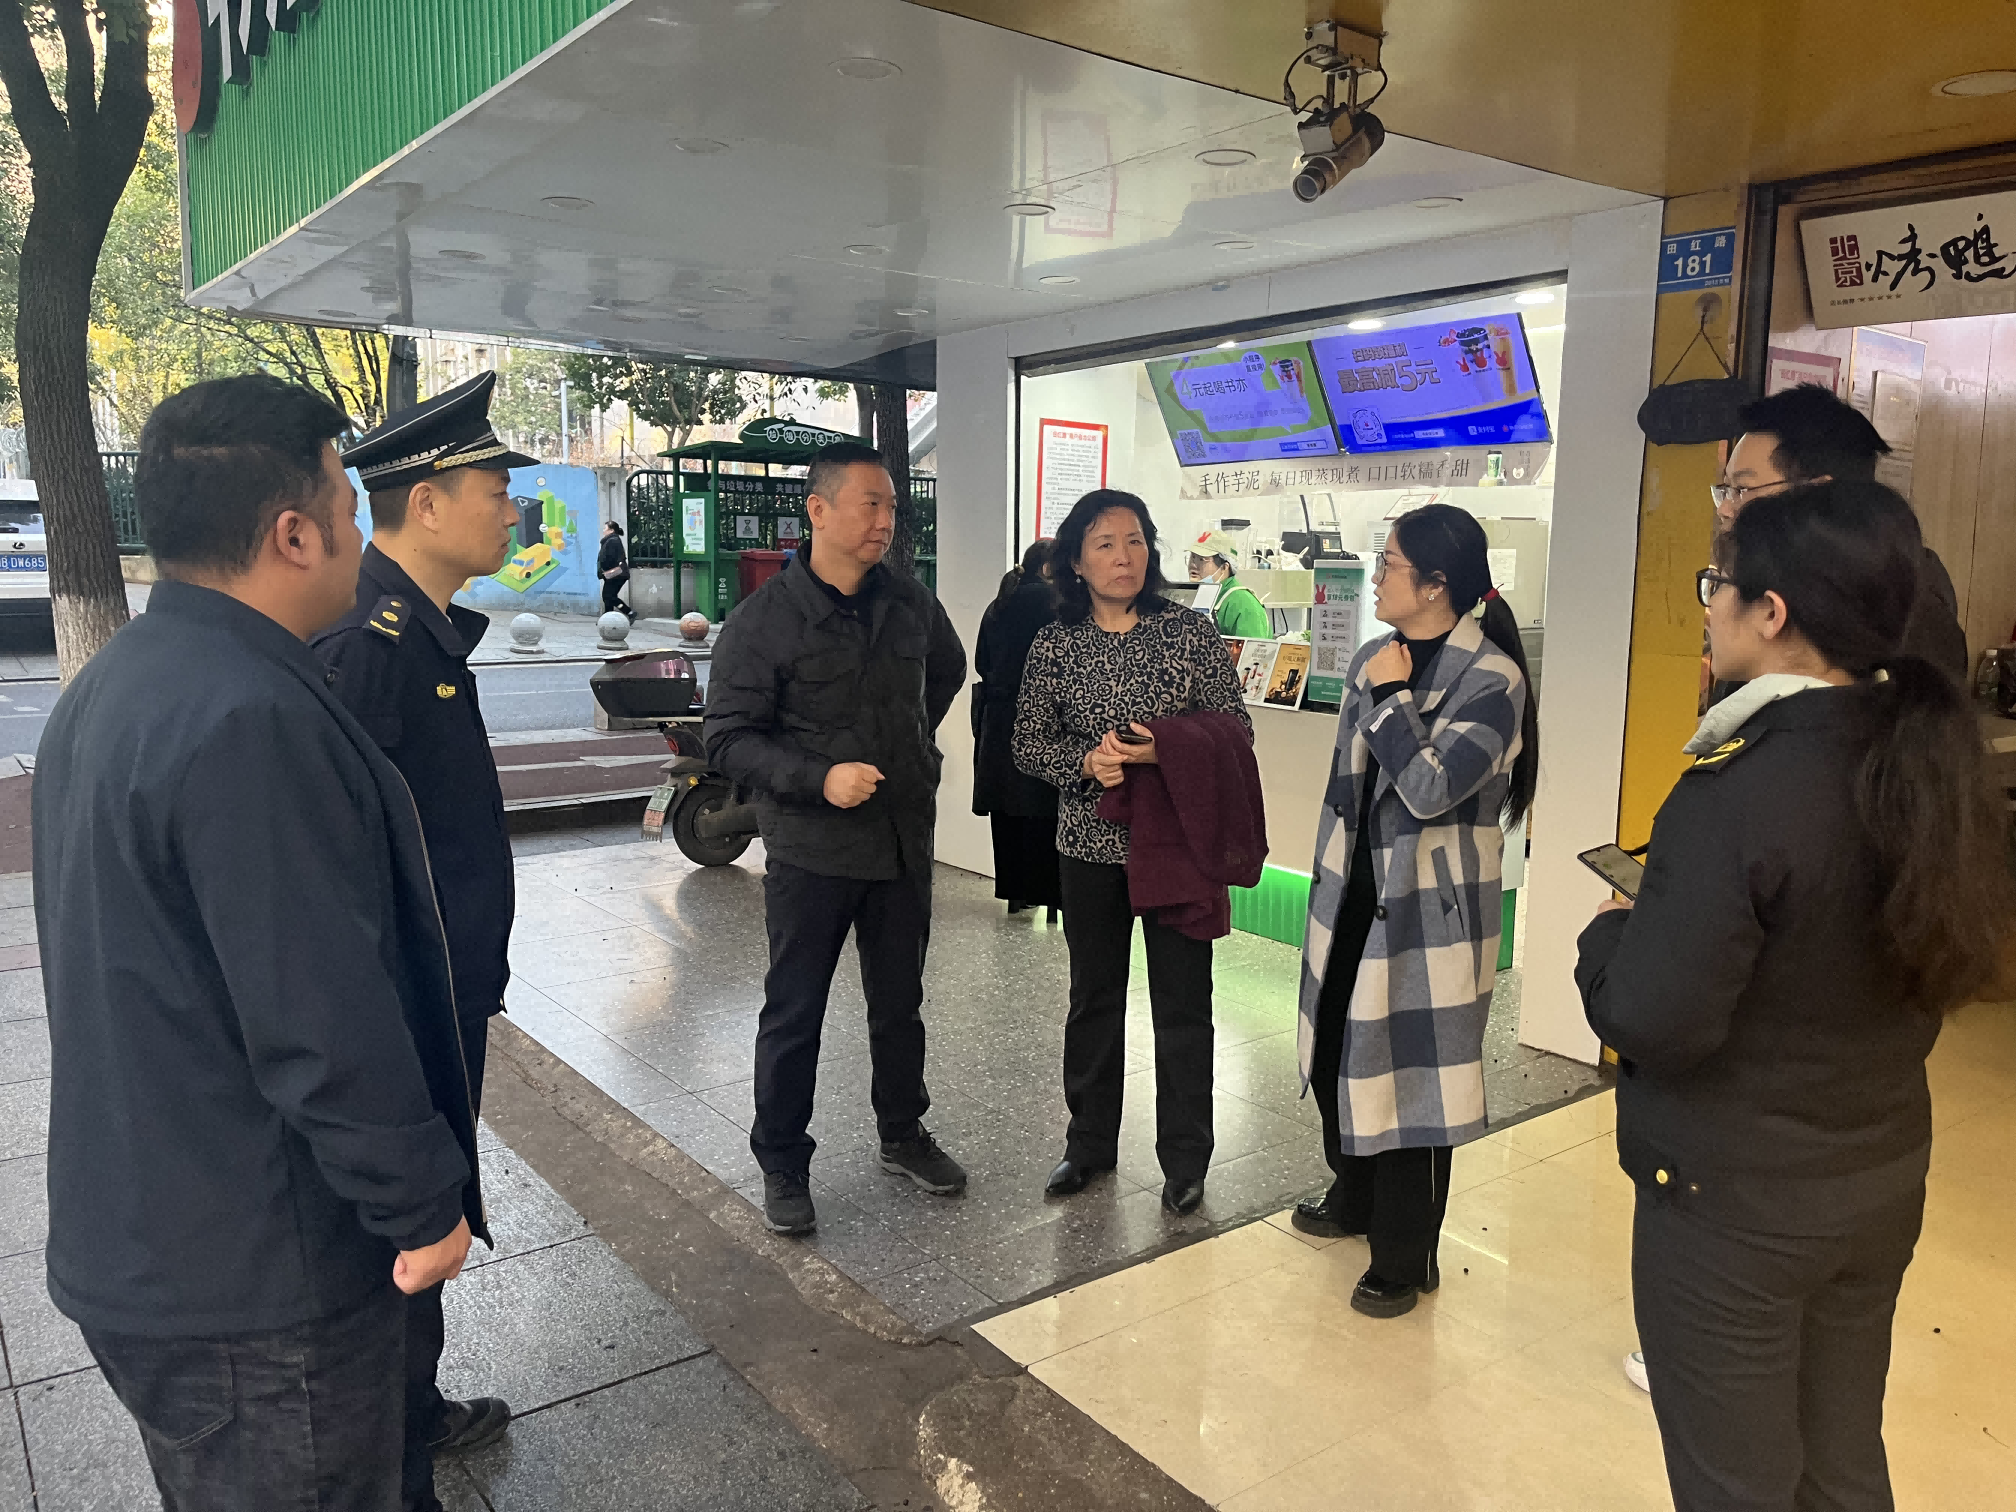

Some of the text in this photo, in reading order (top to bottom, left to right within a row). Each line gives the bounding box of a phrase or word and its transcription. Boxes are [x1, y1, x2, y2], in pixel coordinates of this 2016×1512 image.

[1667, 235, 1727, 254] 田红路
[1829, 212, 2016, 293] 北京 烤鸭
[1674, 253, 1712, 277] 181
[1181, 377, 1248, 399] 4元起喝书亦
[1337, 359, 1441, 394] 最高减5元
[776, 482, 807, 494] 共建
[1200, 458, 1471, 495] 手作芋泥 每日现蒸现煮 口口软糯香甜
